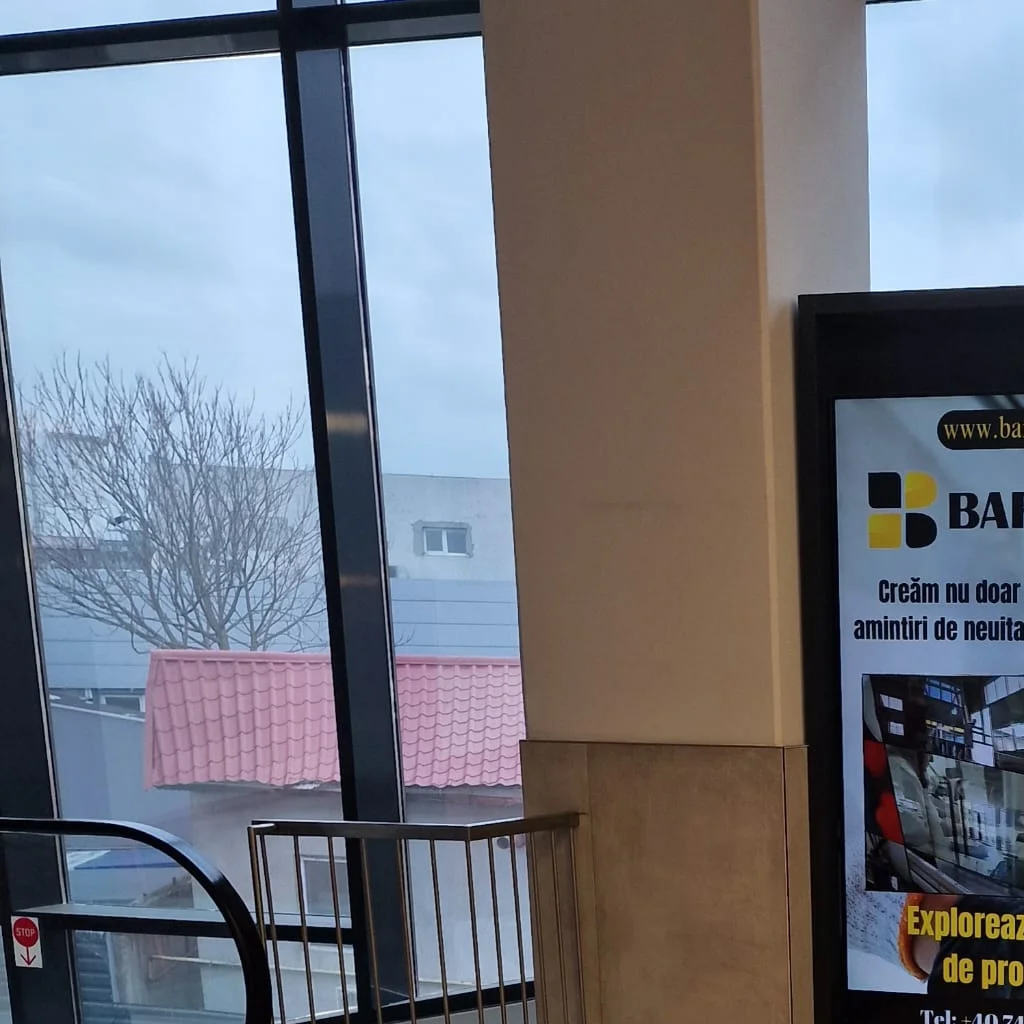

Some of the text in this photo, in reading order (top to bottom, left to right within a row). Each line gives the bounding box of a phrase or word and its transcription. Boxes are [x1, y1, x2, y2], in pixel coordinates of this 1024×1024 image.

[879, 577, 940, 604] Creăm
[945, 583, 970, 604] nu
[976, 579, 1021, 604] doar
[853, 617, 928, 642] amintiri
[934, 617, 958, 641] de
[15, 927, 36, 937] STOP
[942, 953, 974, 983] de
